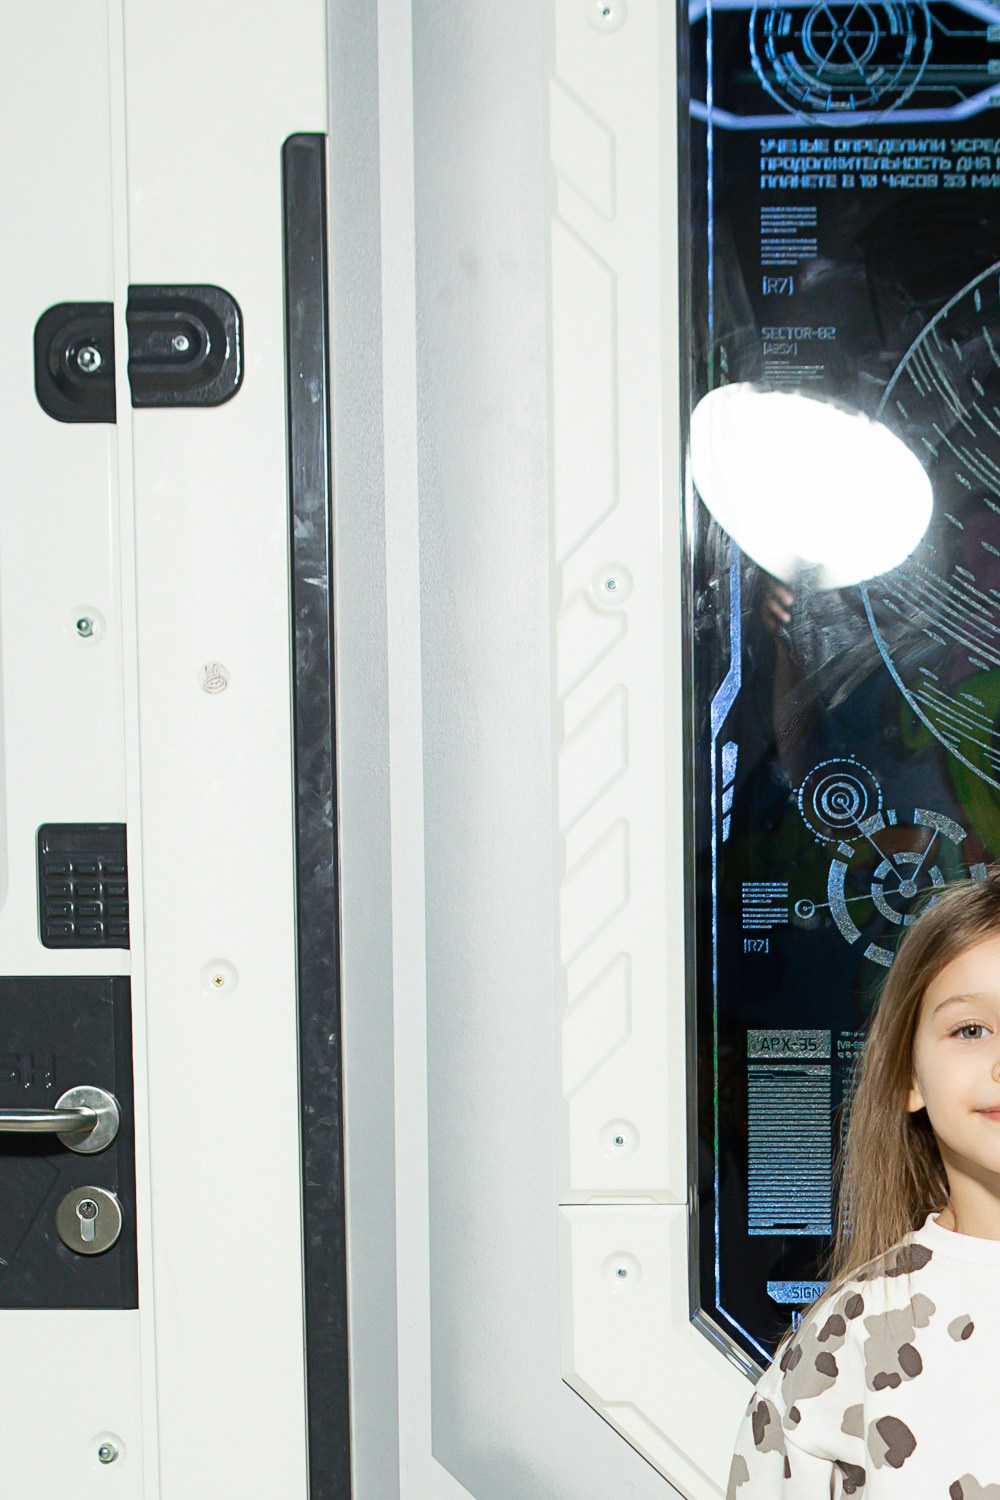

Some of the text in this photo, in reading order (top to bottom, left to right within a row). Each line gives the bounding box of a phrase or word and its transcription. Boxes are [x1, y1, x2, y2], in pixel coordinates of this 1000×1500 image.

[956, 156, 992, 173] ДНЯ
[842, 174, 855, 189] В
[882, 173, 939, 189] ЧАСОВ
[761, 326, 837, 340] SECTOR-02
[760, 1037, 818, 1052] APX-35
